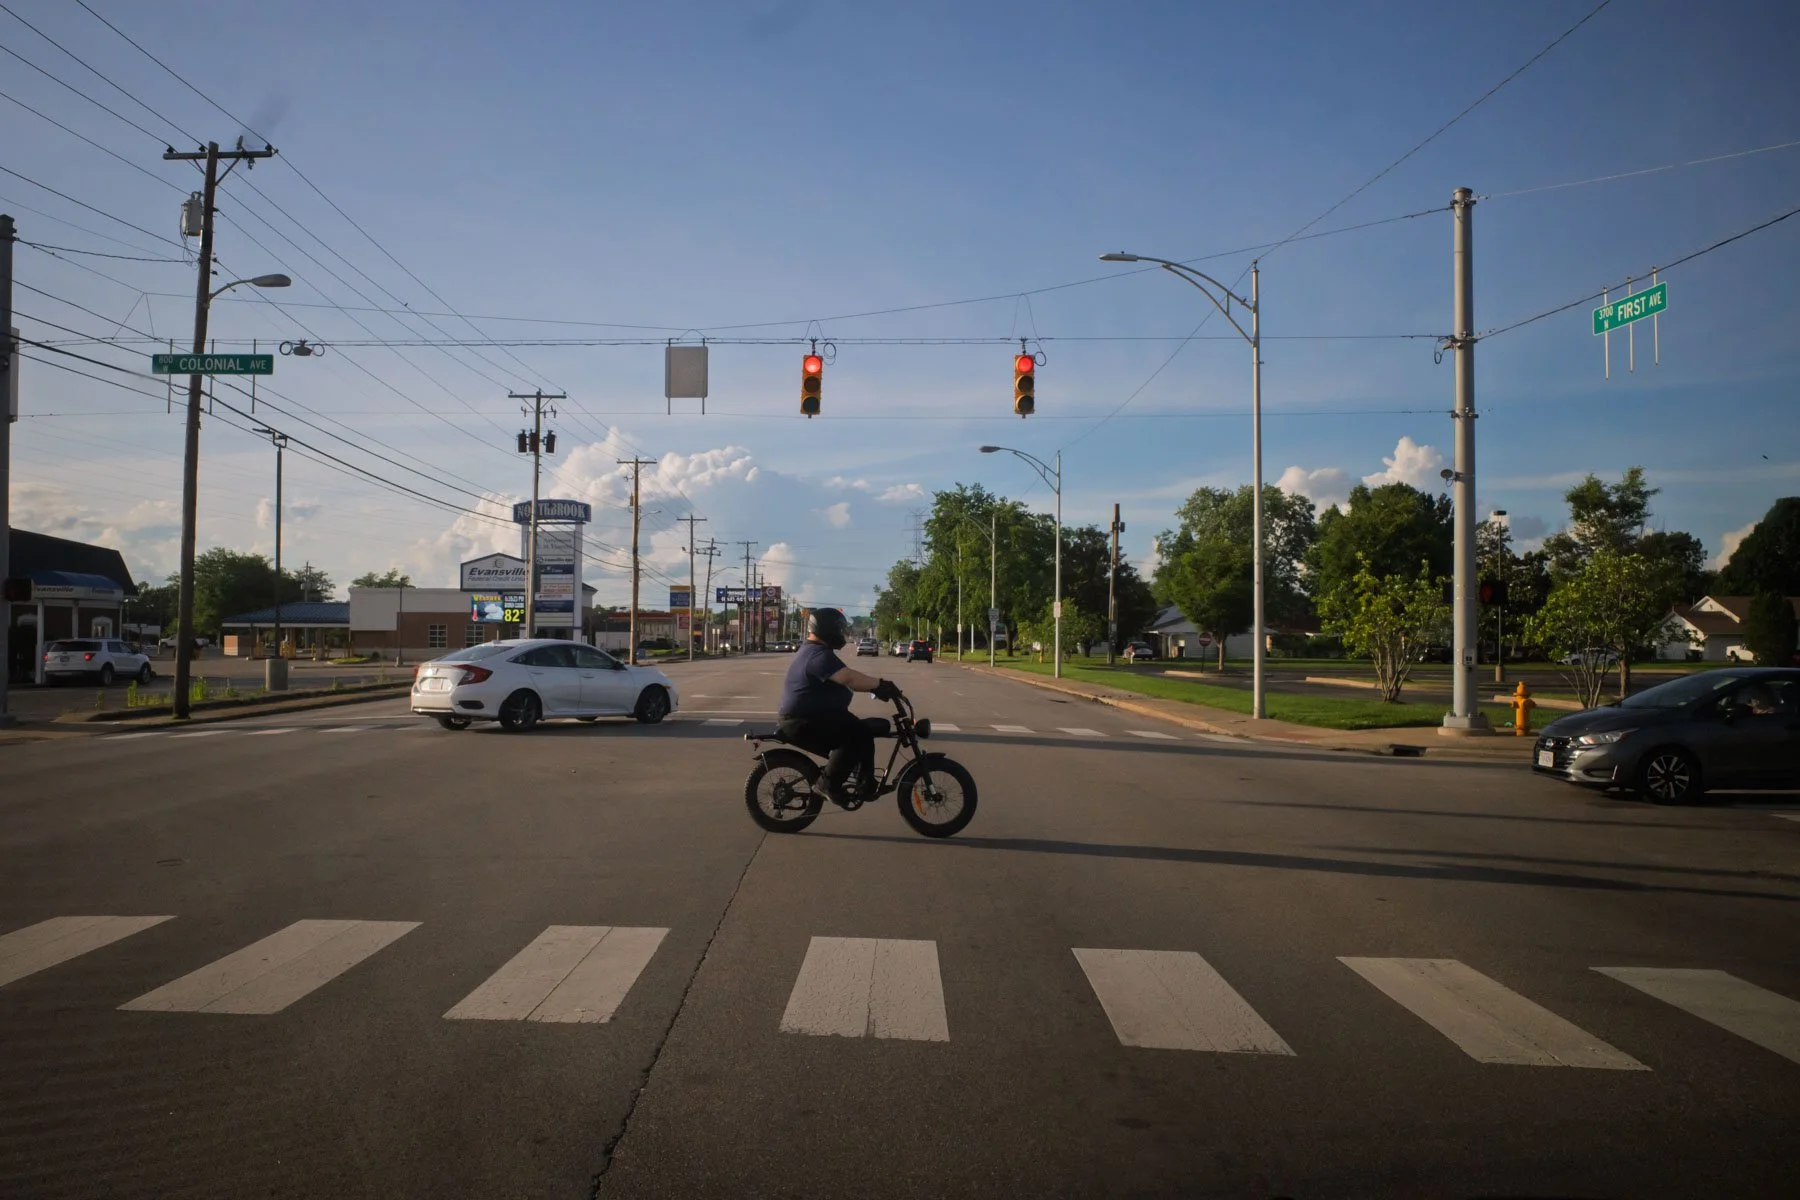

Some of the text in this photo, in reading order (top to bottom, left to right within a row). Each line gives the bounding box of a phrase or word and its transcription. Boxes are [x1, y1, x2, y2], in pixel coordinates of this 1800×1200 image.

[1618, 291, 1662, 321] FIRST AVE
[180, 358, 267, 371] COLONIAL AVE
[517, 502, 586, 519] NOTHBROOK
[469, 568, 529, 576] Evansville
